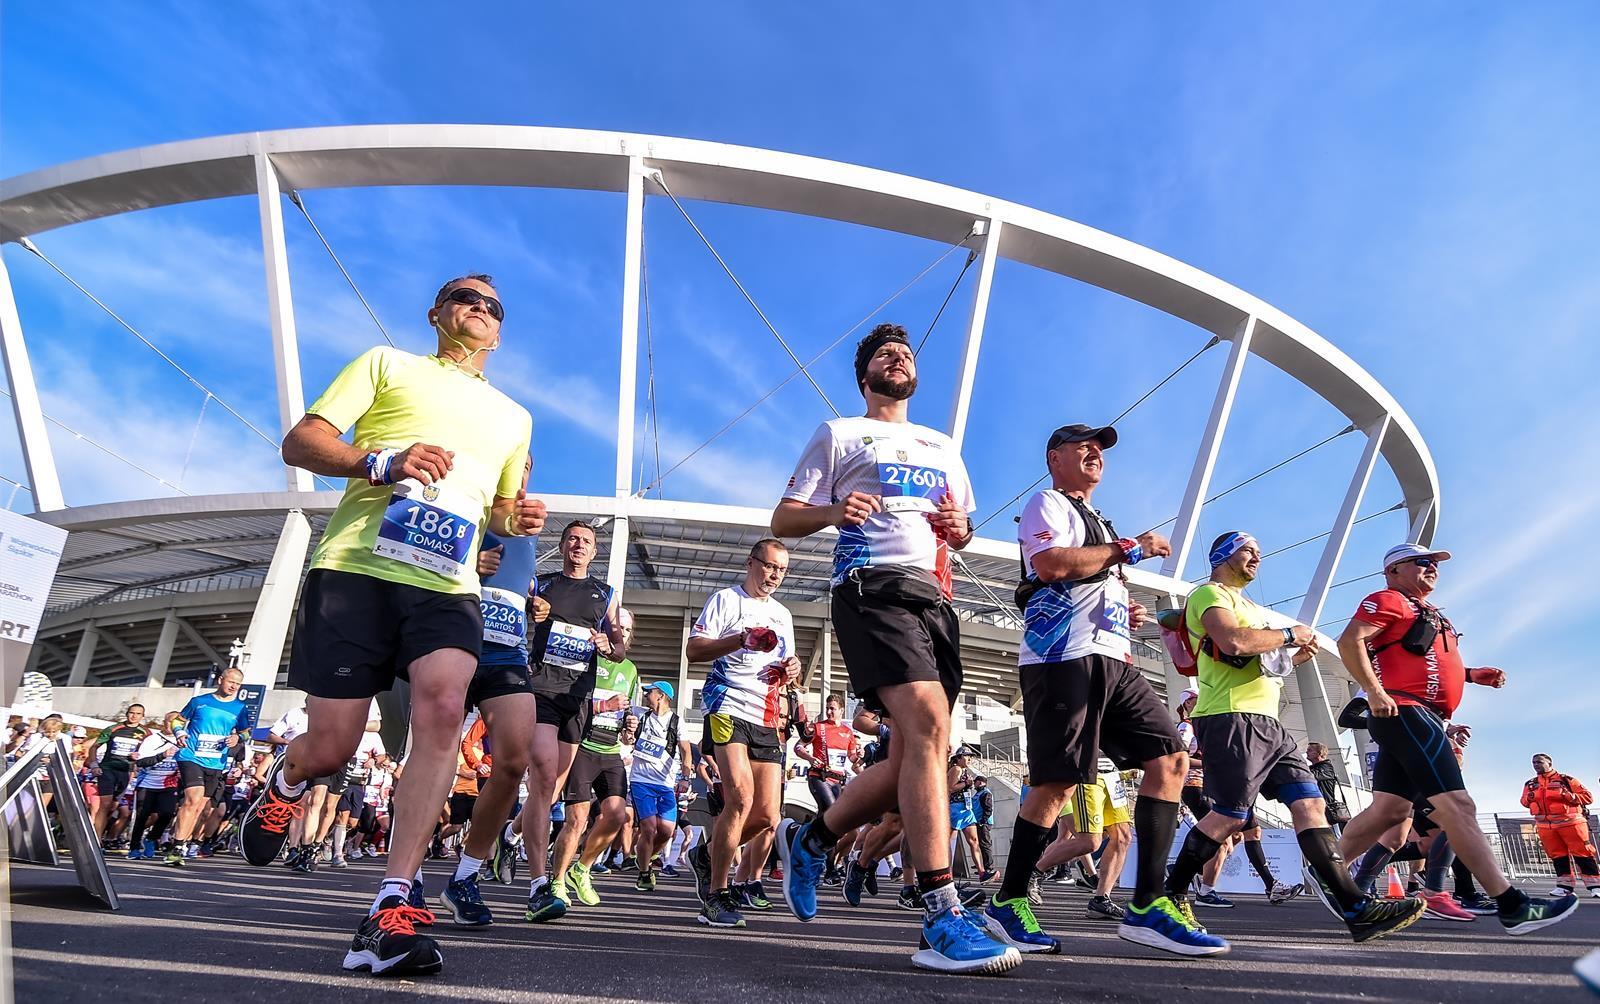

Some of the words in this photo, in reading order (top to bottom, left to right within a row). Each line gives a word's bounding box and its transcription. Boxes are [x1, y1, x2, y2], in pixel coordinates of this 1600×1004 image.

[885, 466, 937, 488] 2760
[937, 477, 945, 488] B
[404, 506, 455, 539] 186
[456, 524, 466, 539] B
[407, 530, 455, 556] TOMASZ
[480, 603, 516, 625] 2236
[517, 615, 523, 624] B
[484, 620, 516, 633] BARTOSZ
[551, 635, 586, 653] 2288
[553, 649, 586, 661] KRZYSZTOF
[640, 740, 656, 751] 479
